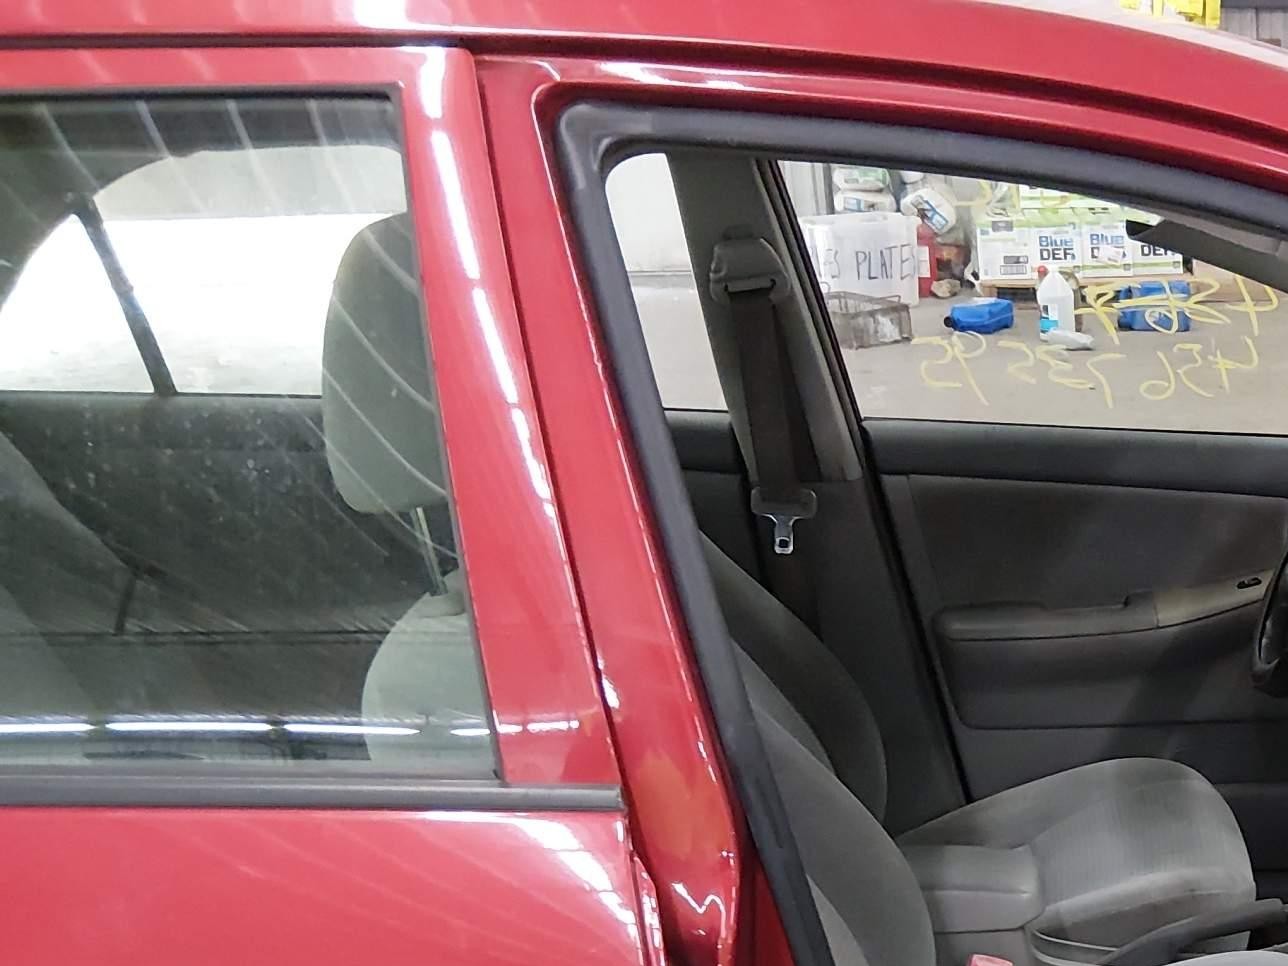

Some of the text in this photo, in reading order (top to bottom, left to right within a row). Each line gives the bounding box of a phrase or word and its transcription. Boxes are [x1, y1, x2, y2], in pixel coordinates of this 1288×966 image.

[1039, 235, 1074, 248] Blue
[1090, 233, 1125, 246] Blue
[1039, 248, 1072, 261] DEF
